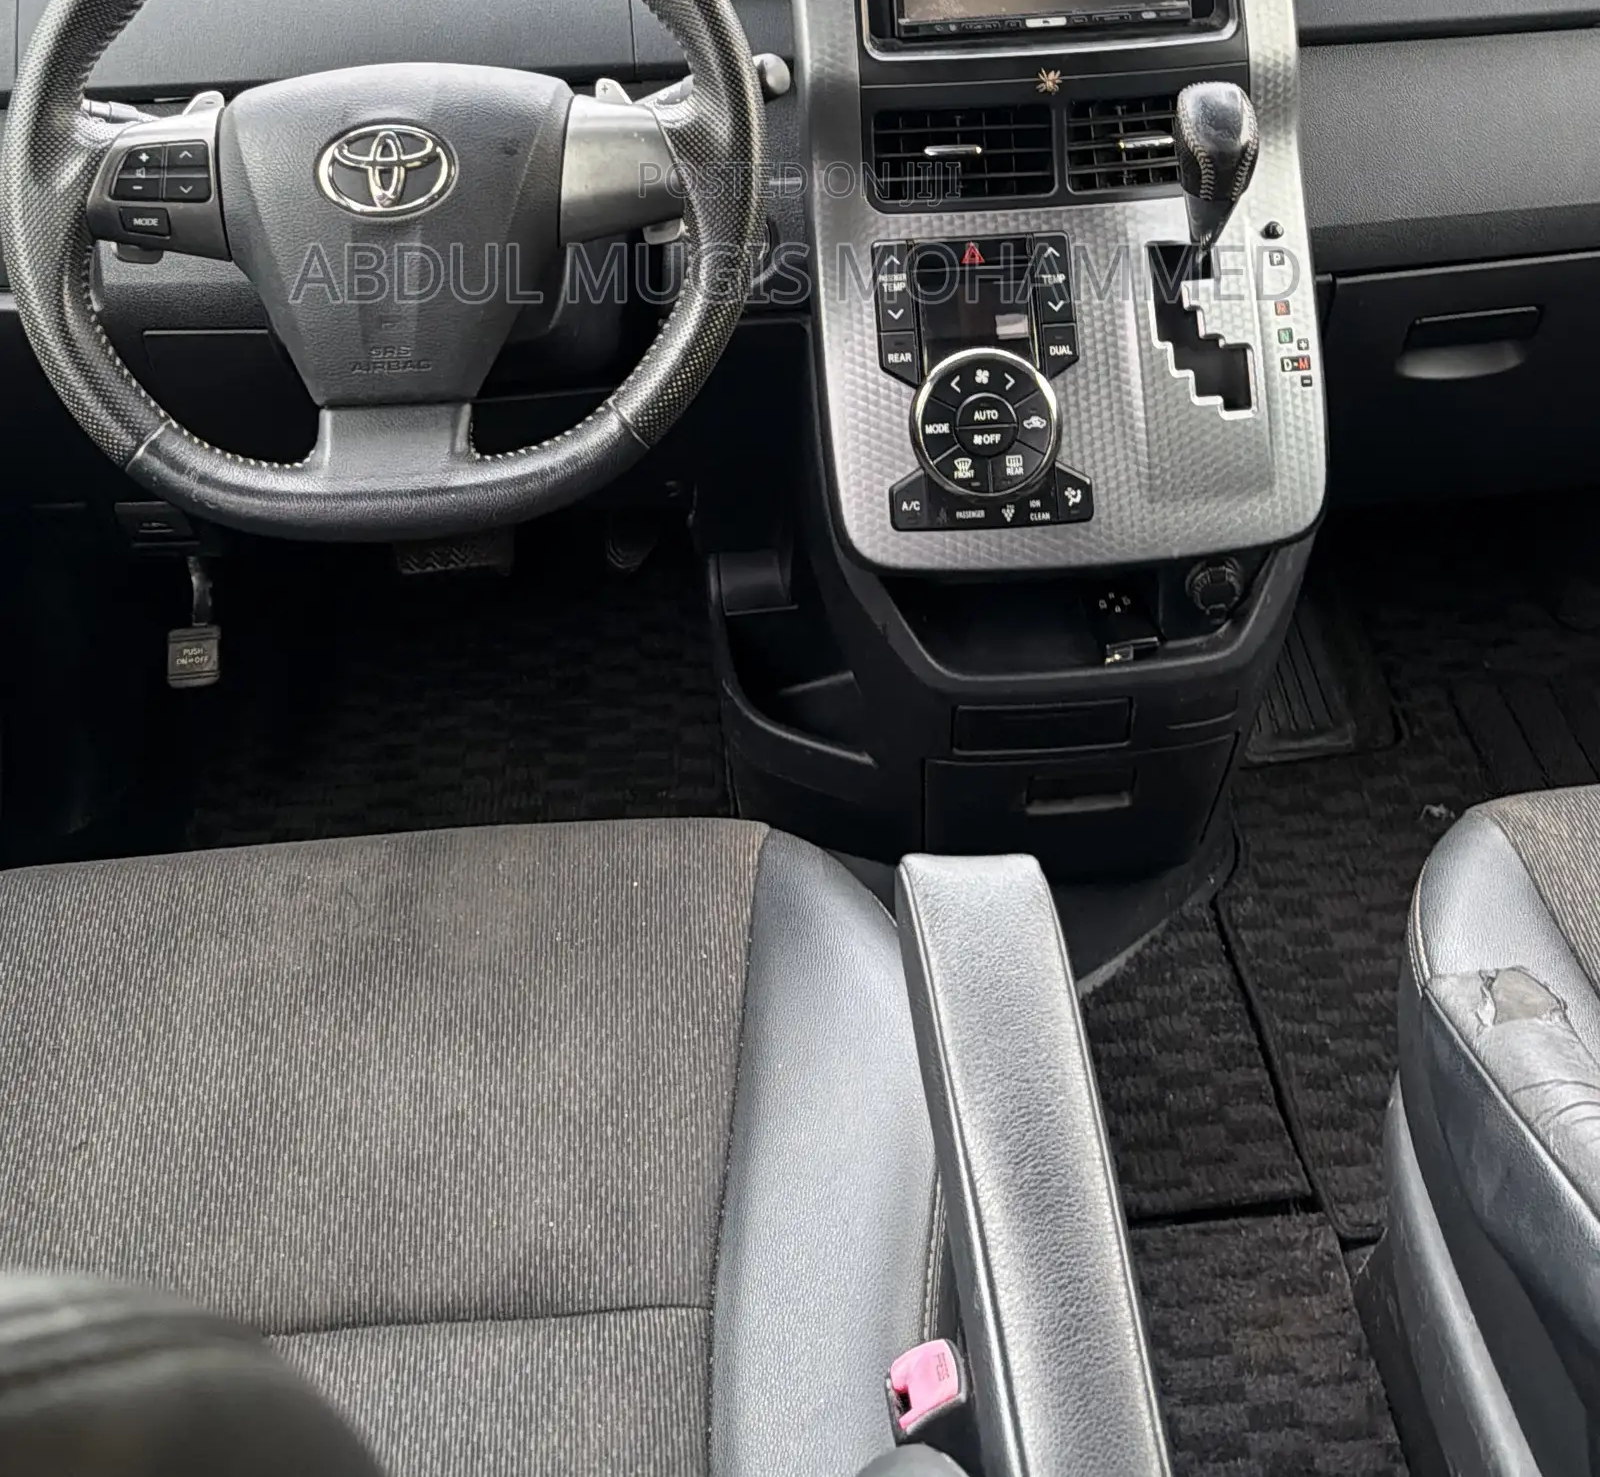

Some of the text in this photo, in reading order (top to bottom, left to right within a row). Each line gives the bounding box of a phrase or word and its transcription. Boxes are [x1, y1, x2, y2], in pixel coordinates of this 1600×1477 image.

[133, 217, 159, 227] MODE
[1041, 273, 1066, 284] TEMP
[882, 281, 906, 293] TEMP
[1049, 344, 1073, 356] DUAL
[888, 352, 912, 364] REAR
[973, 410, 999, 421] AUTO
[925, 423, 950, 434] MODE
[983, 434, 1002, 444] OFF
[954, 469, 975, 479] FRONT
[1006, 467, 1024, 476] REAR
[902, 500, 921, 512] A/C
[956, 509, 986, 520] PASSENGER
[1029, 511, 1050, 522] CLEAN
[183, 647, 204, 656] PUSH
